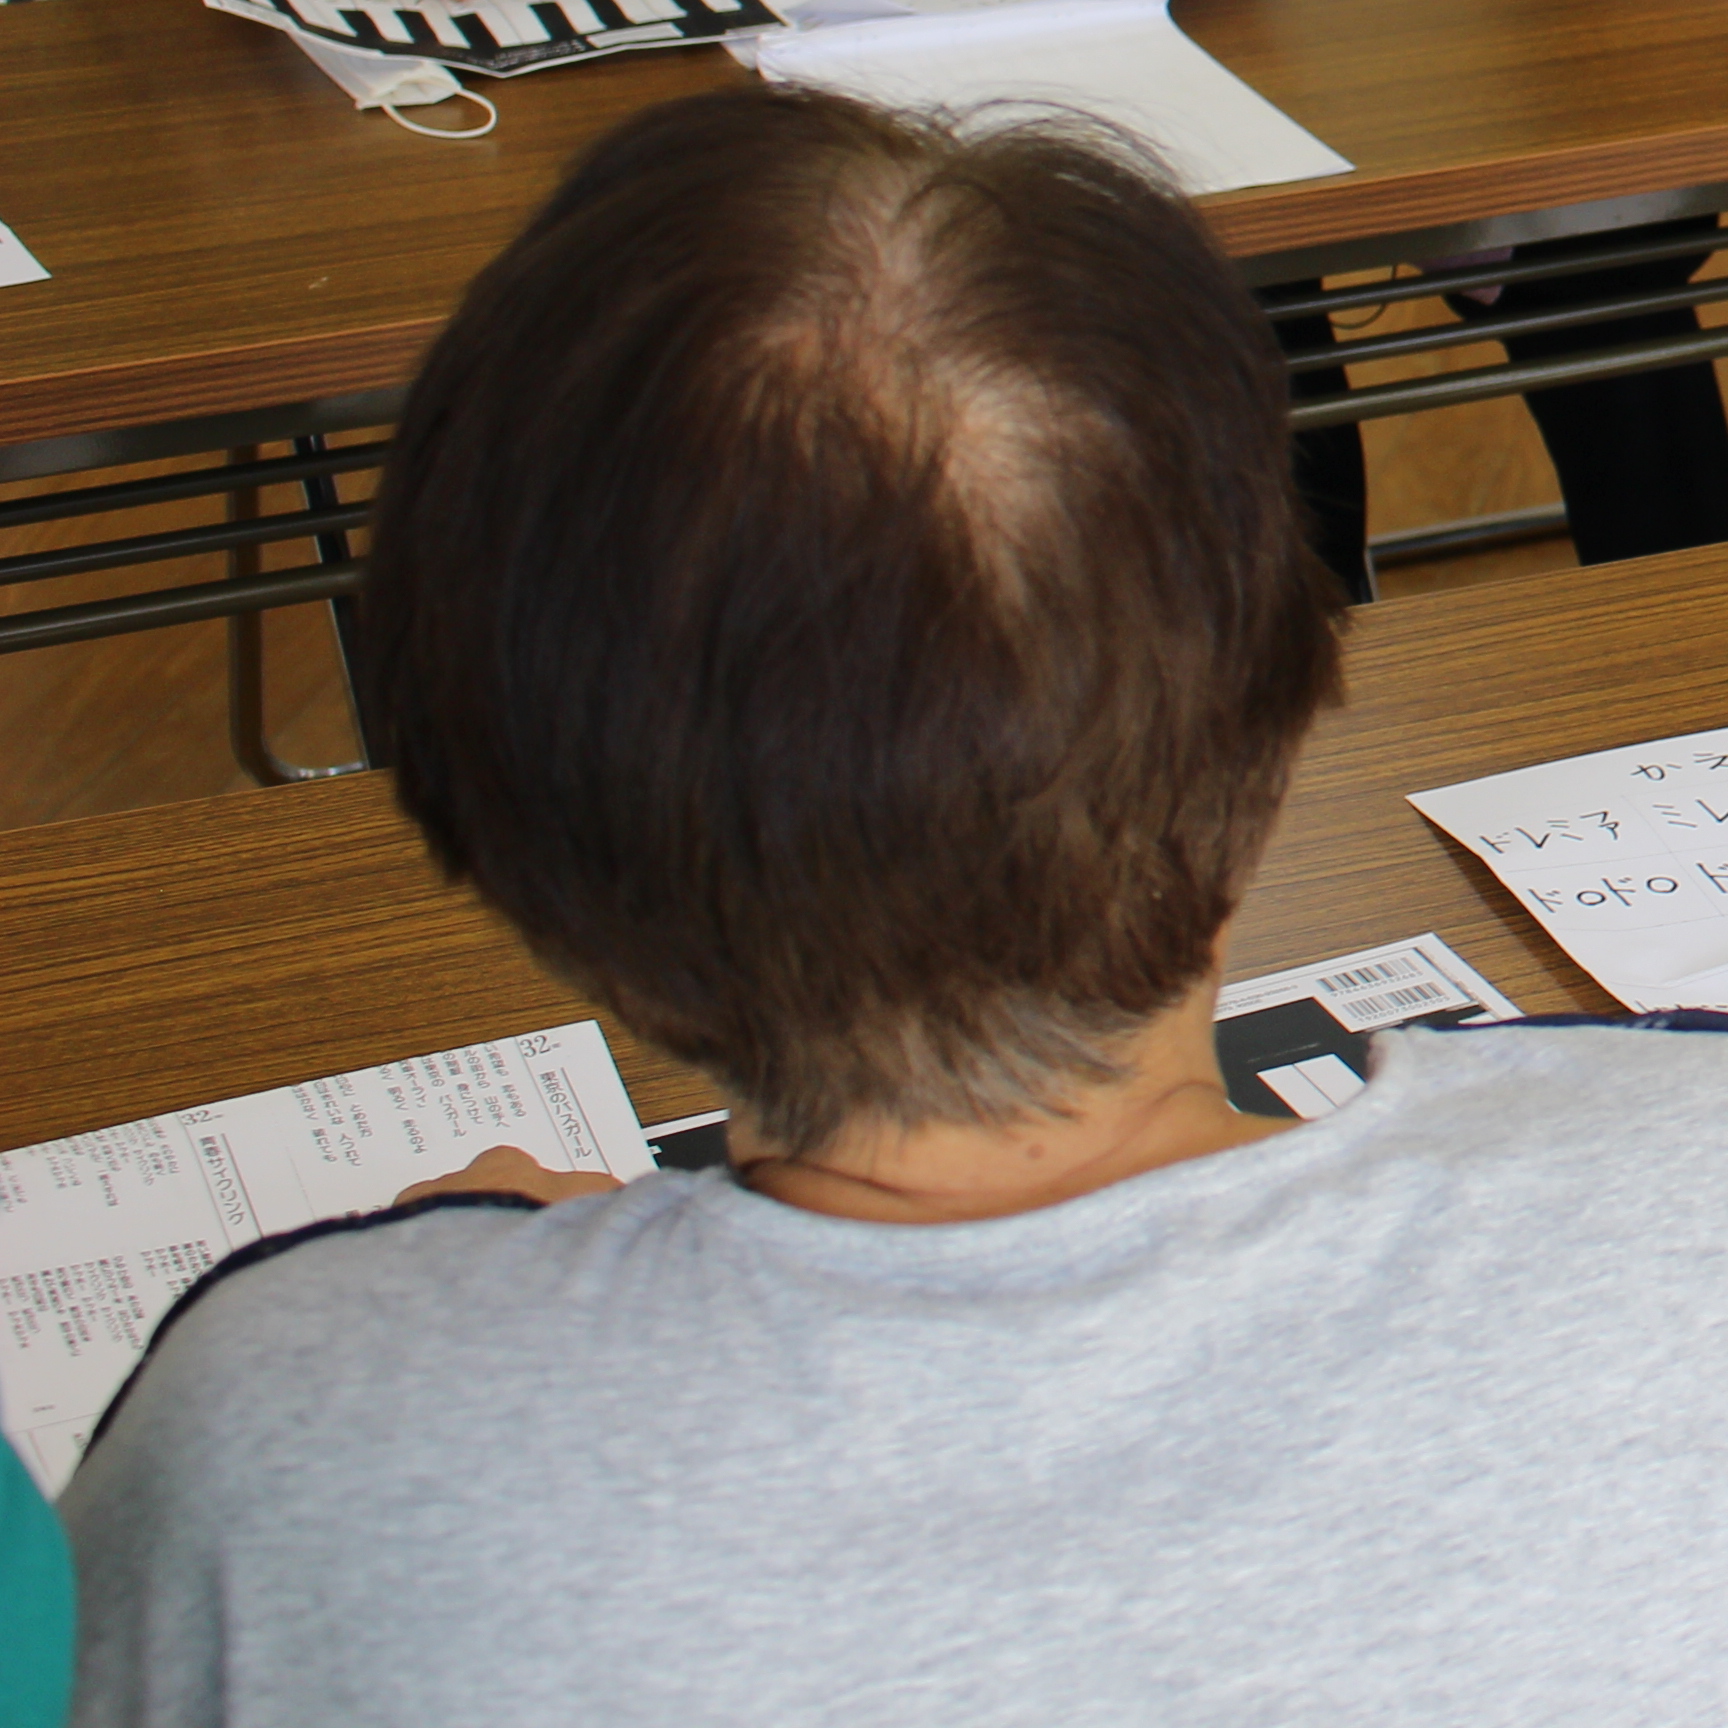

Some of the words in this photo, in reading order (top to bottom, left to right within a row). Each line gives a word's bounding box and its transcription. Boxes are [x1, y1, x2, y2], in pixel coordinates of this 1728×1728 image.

[519, 1035, 551, 1058] 32
[181, 1109, 211, 1127] 32
[539, 1070, 593, 1159] 東京のバスガール
